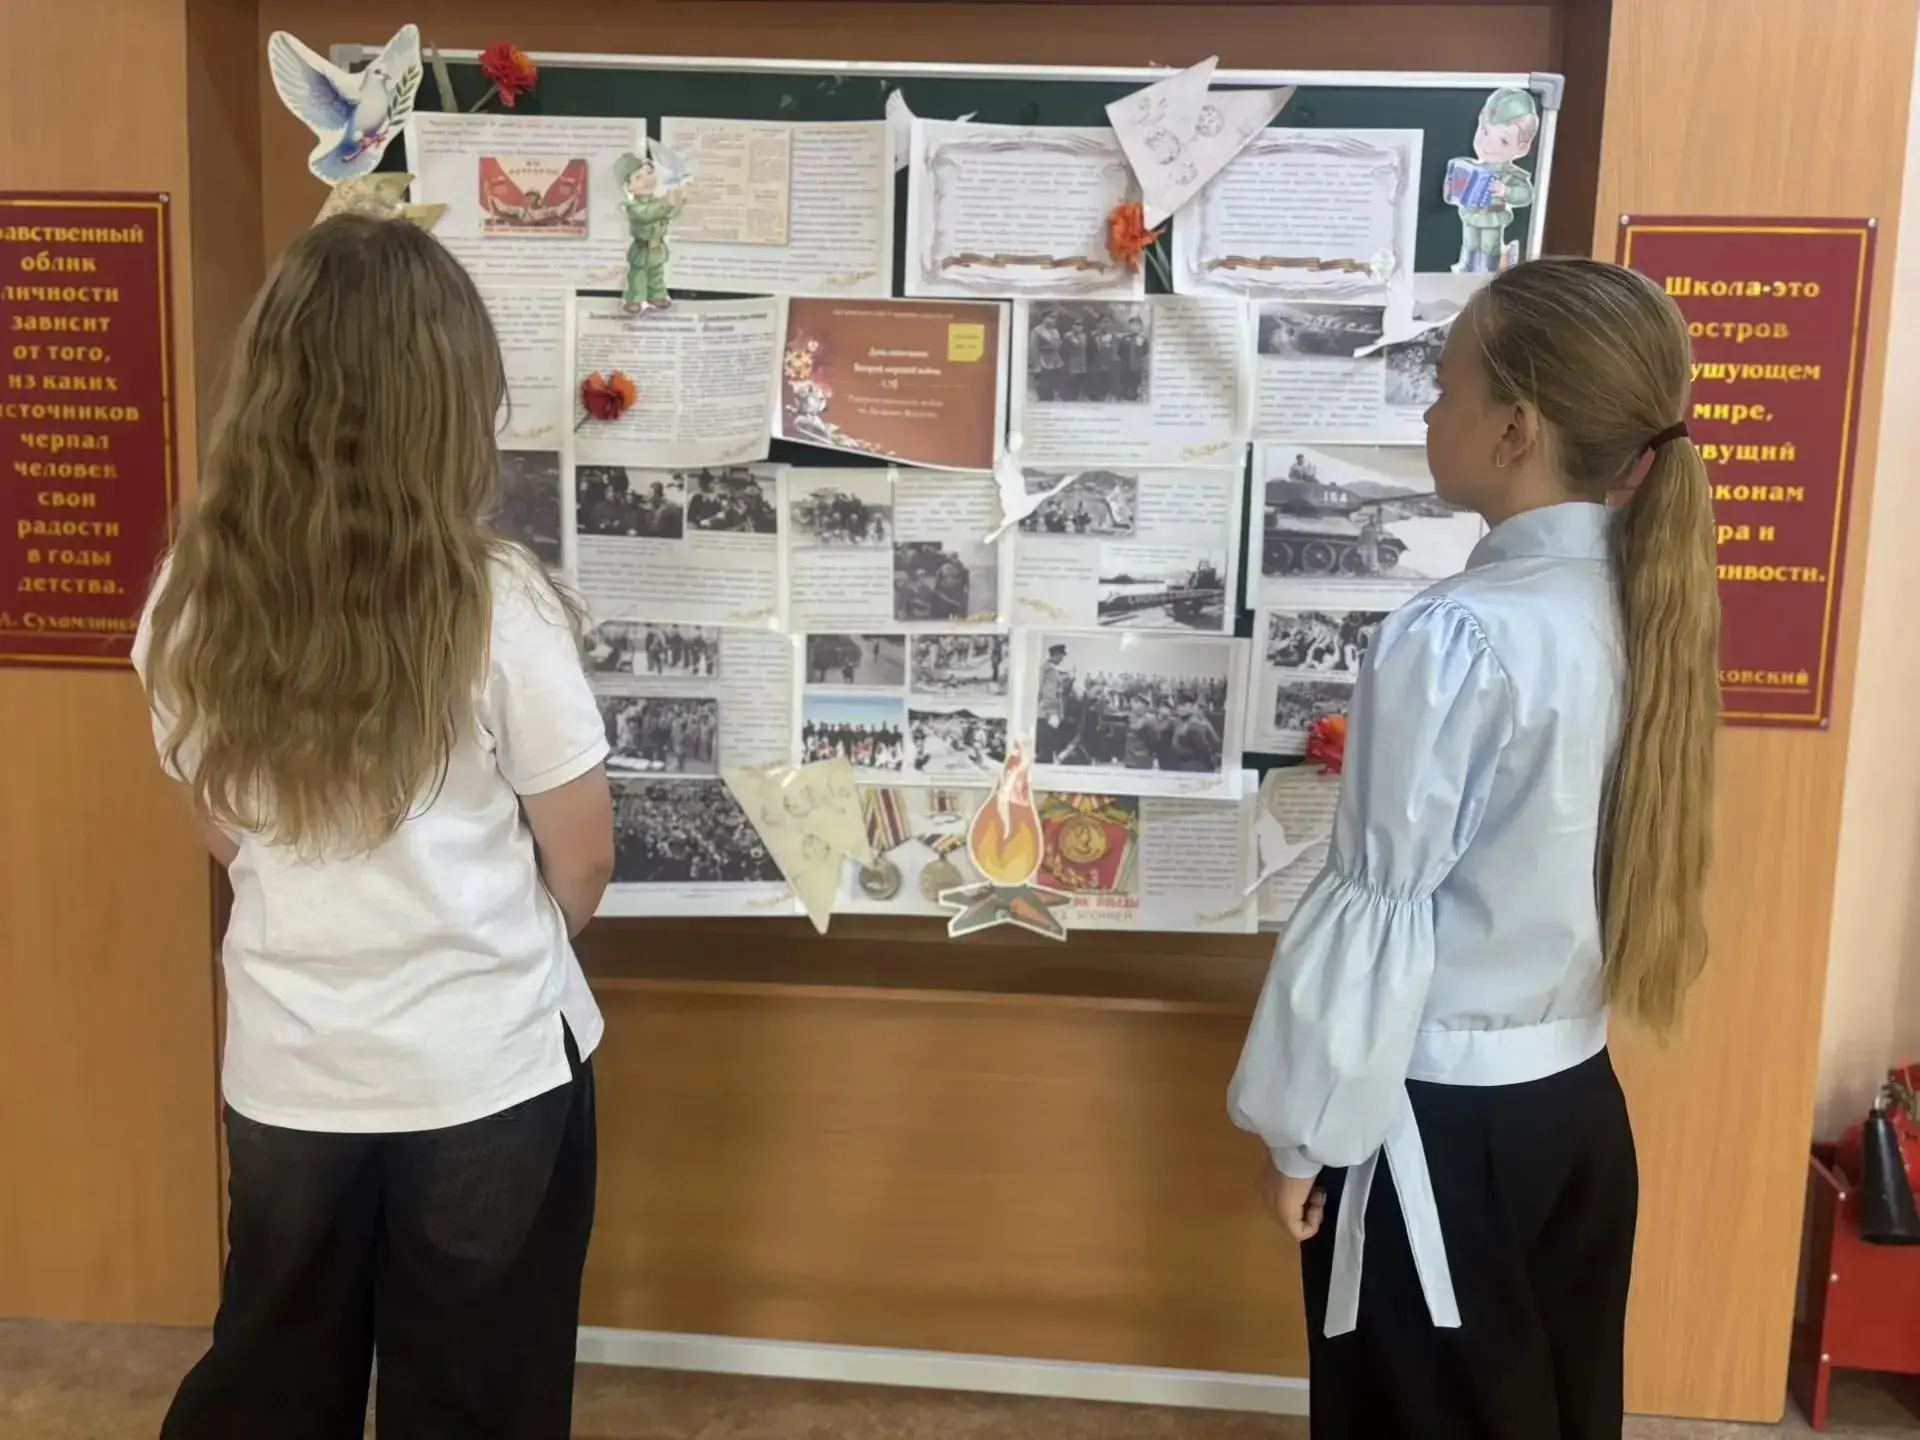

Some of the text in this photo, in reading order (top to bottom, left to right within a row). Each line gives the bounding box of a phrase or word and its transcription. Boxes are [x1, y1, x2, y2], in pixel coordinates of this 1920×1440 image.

[20, 250, 97, 272] облик
[1, 285, 120, 303] личности
[1664, 276, 1820, 298] Школа-это
[12, 315, 111, 332] зависит
[1688, 321, 1789, 343] остров
[12, 345, 111, 364] от того,
[1690, 362, 1821, 384] ушующем
[8, 374, 118, 392] из каких
[1692, 403, 1774, 425] мире,
[20, 432, 109, 453] черпал
[1696, 442, 1796, 465] вущий
[13, 461, 117, 479] человек
[37, 491, 96, 508] свои
[1709, 484, 1805, 502] конам
[17, 519, 119, 539] радости
[1758, 525, 1775, 542] и
[27, 548, 112, 566] в годы
[1716, 564, 1826, 583] ливости.
[17, 576, 124, 596] детства.
[1718, 668, 1809, 686] ковский
